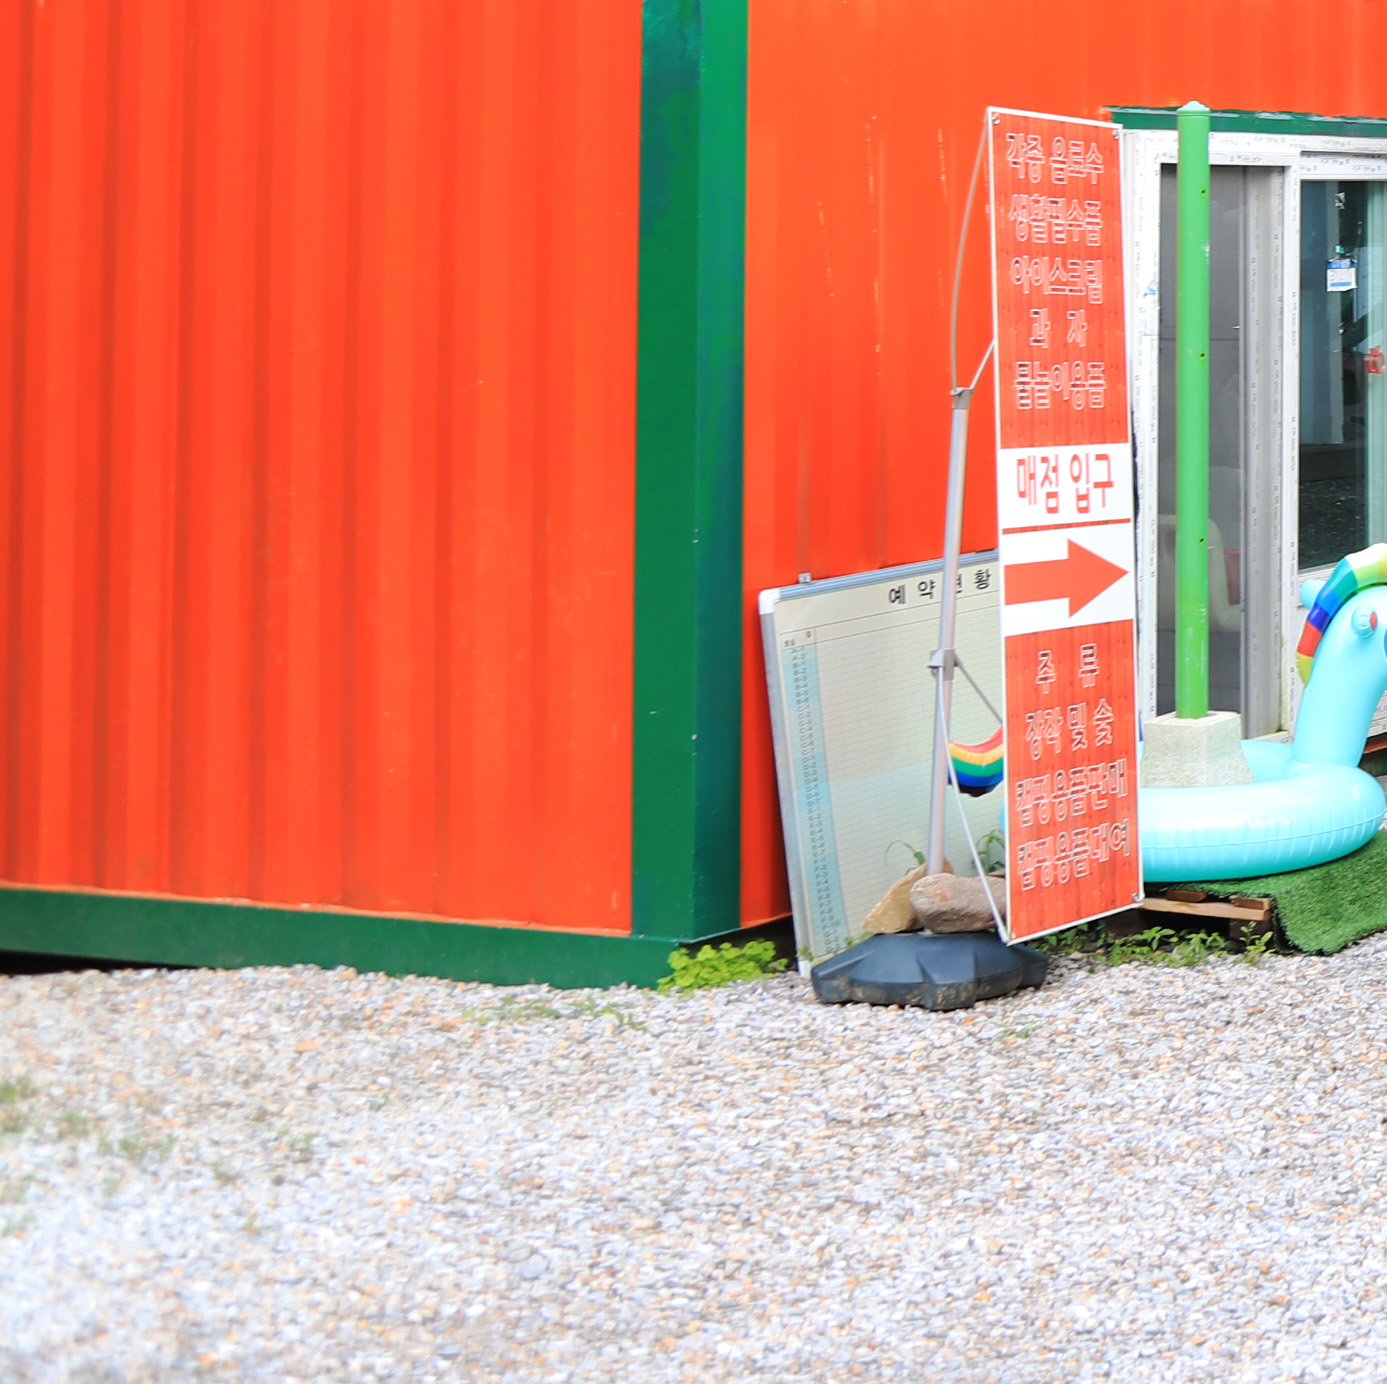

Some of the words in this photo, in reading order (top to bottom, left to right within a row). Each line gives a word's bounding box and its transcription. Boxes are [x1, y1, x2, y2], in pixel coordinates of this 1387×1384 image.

[1005, 133, 1045, 183] 각종
[1048, 136, 1104, 184] 음료수
[1008, 193, 1103, 246] 생활필수품
[1010, 255, 1104, 304] 아이스크림
[1014, 360, 1106, 410] 물놀이용품
[1016, 453, 1059, 514] 매점
[1069, 452, 1114, 514] 입구
[1025, 706, 1065, 760] 장작
[1067, 701, 1088, 752] 및
[1092, 698, 1115, 747] 숯
[1015, 758, 1128, 827] 캠핑용품판매
[1017, 818, 1130, 891] 캠핑용품대여
